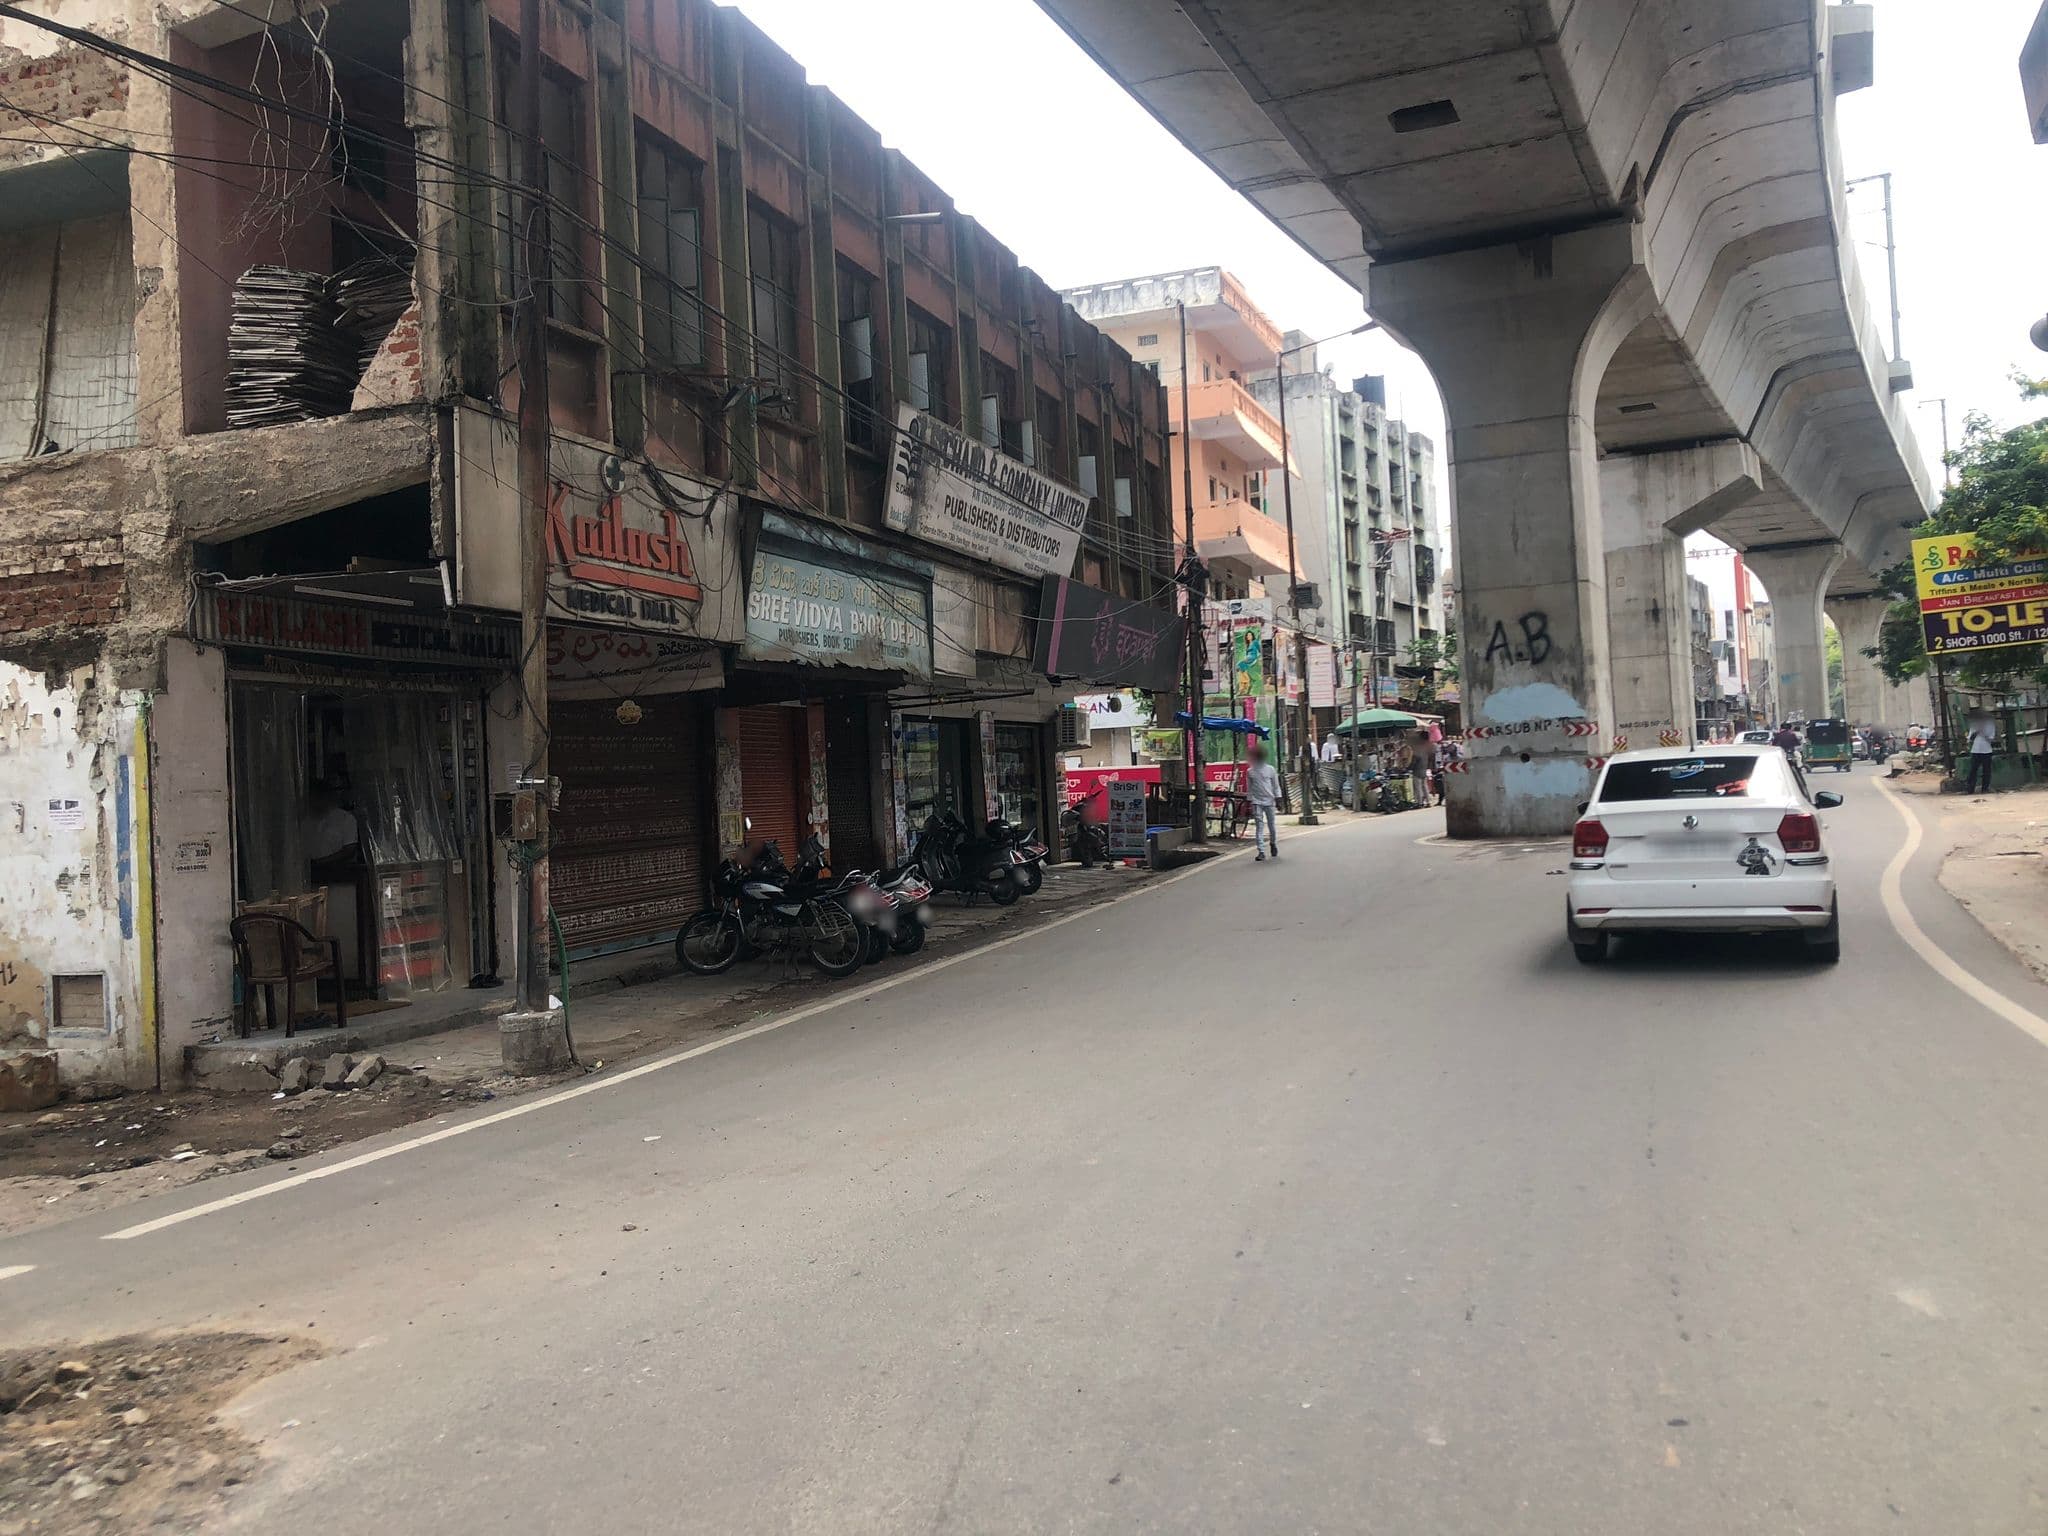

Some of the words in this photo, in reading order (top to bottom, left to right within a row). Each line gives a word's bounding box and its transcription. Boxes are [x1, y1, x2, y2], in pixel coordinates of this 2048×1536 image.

[999, 462, 1051, 513] COMPANY
[1049, 487, 1086, 529] LIMITED
[545, 483, 694, 578] Kailash
[943, 494, 999, 534] PUBLISHERS
[999, 517, 1005, 537] &
[1006, 521, 1061, 558] DISTRIBUTORS
[1929, 587, 1957, 596] Tiffins
[1941, 573, 1969, 584] A/c.
[748, 590, 790, 625] SREE
[792, 597, 844, 634] VIDYA
[850, 609, 887, 641] BOOK
[1939, 597, 1960, 608] JAIN
[1934, 636, 1944, 650] 2
[1946, 635, 1978, 649] SHOPS
[1980, 632, 2007, 645] 1000
